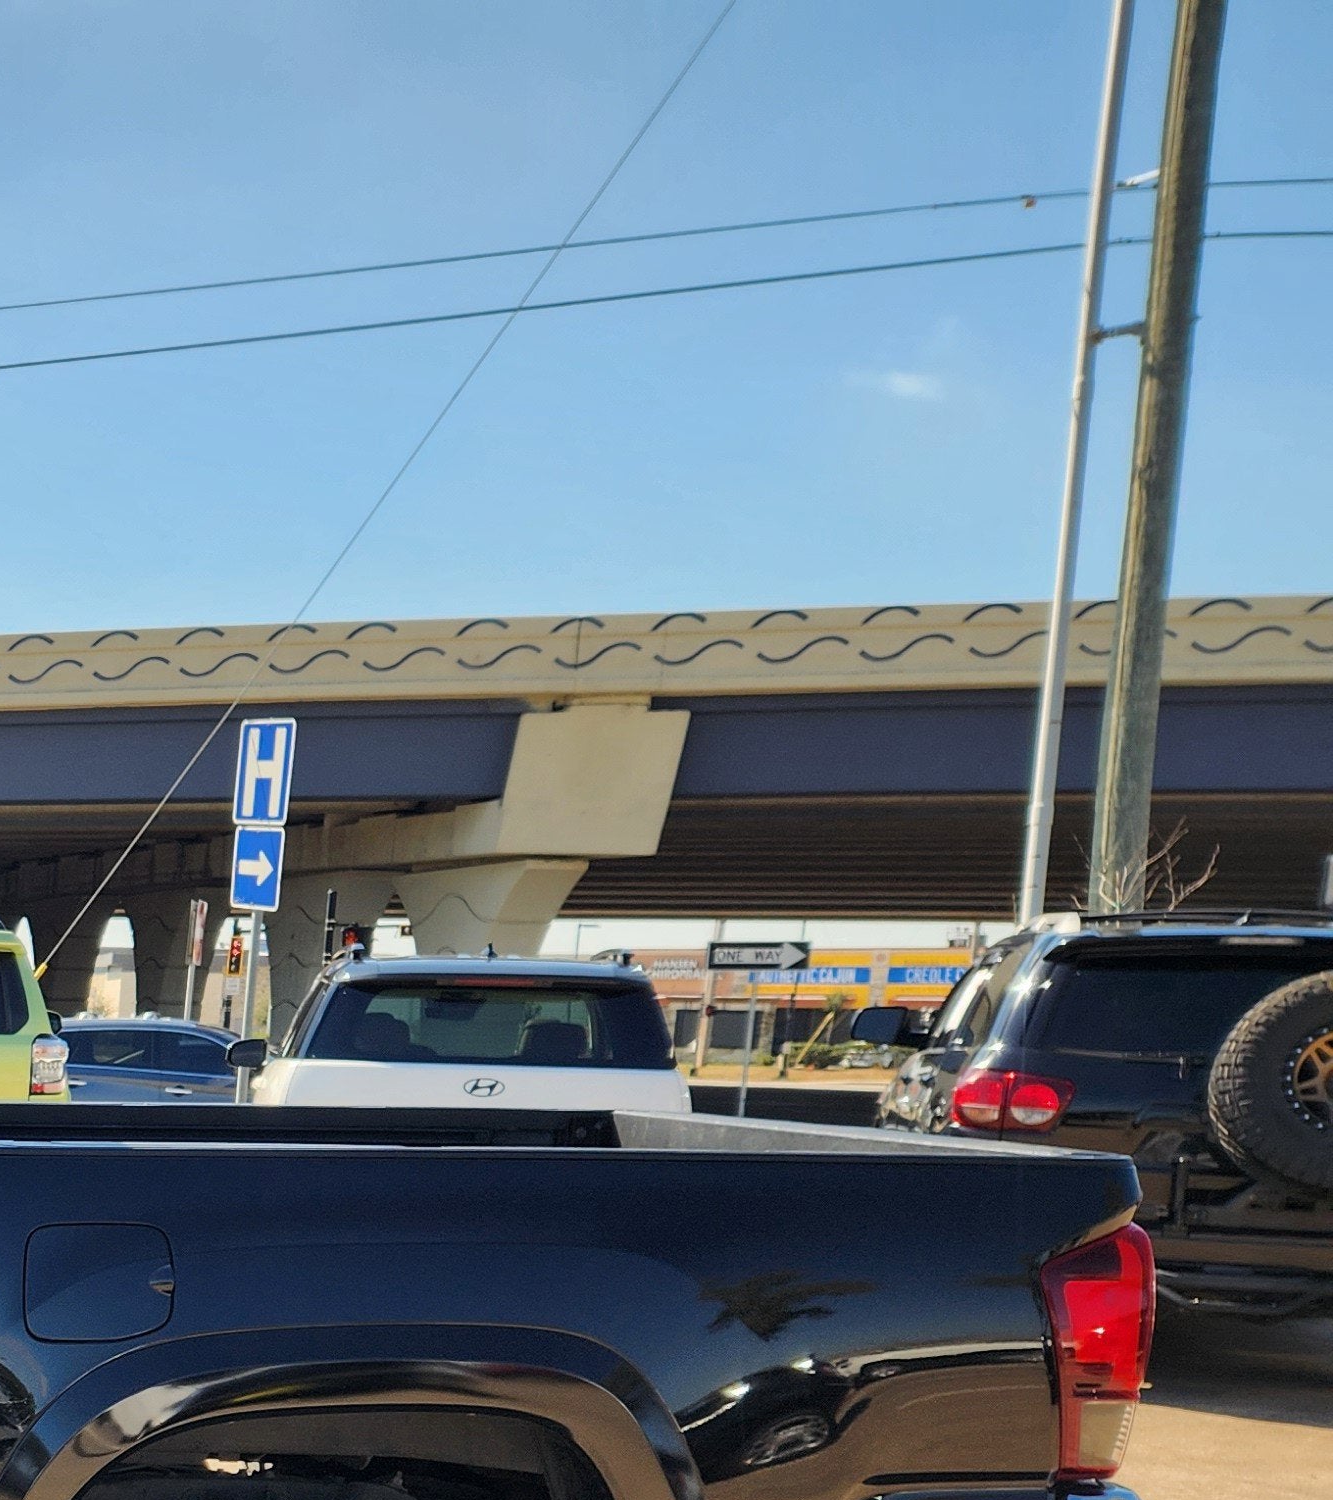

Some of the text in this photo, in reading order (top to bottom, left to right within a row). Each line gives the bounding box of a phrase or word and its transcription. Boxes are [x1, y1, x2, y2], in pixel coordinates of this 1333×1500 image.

[242, 727, 287, 818] H
[717, 951, 782, 963] ONE WAY
